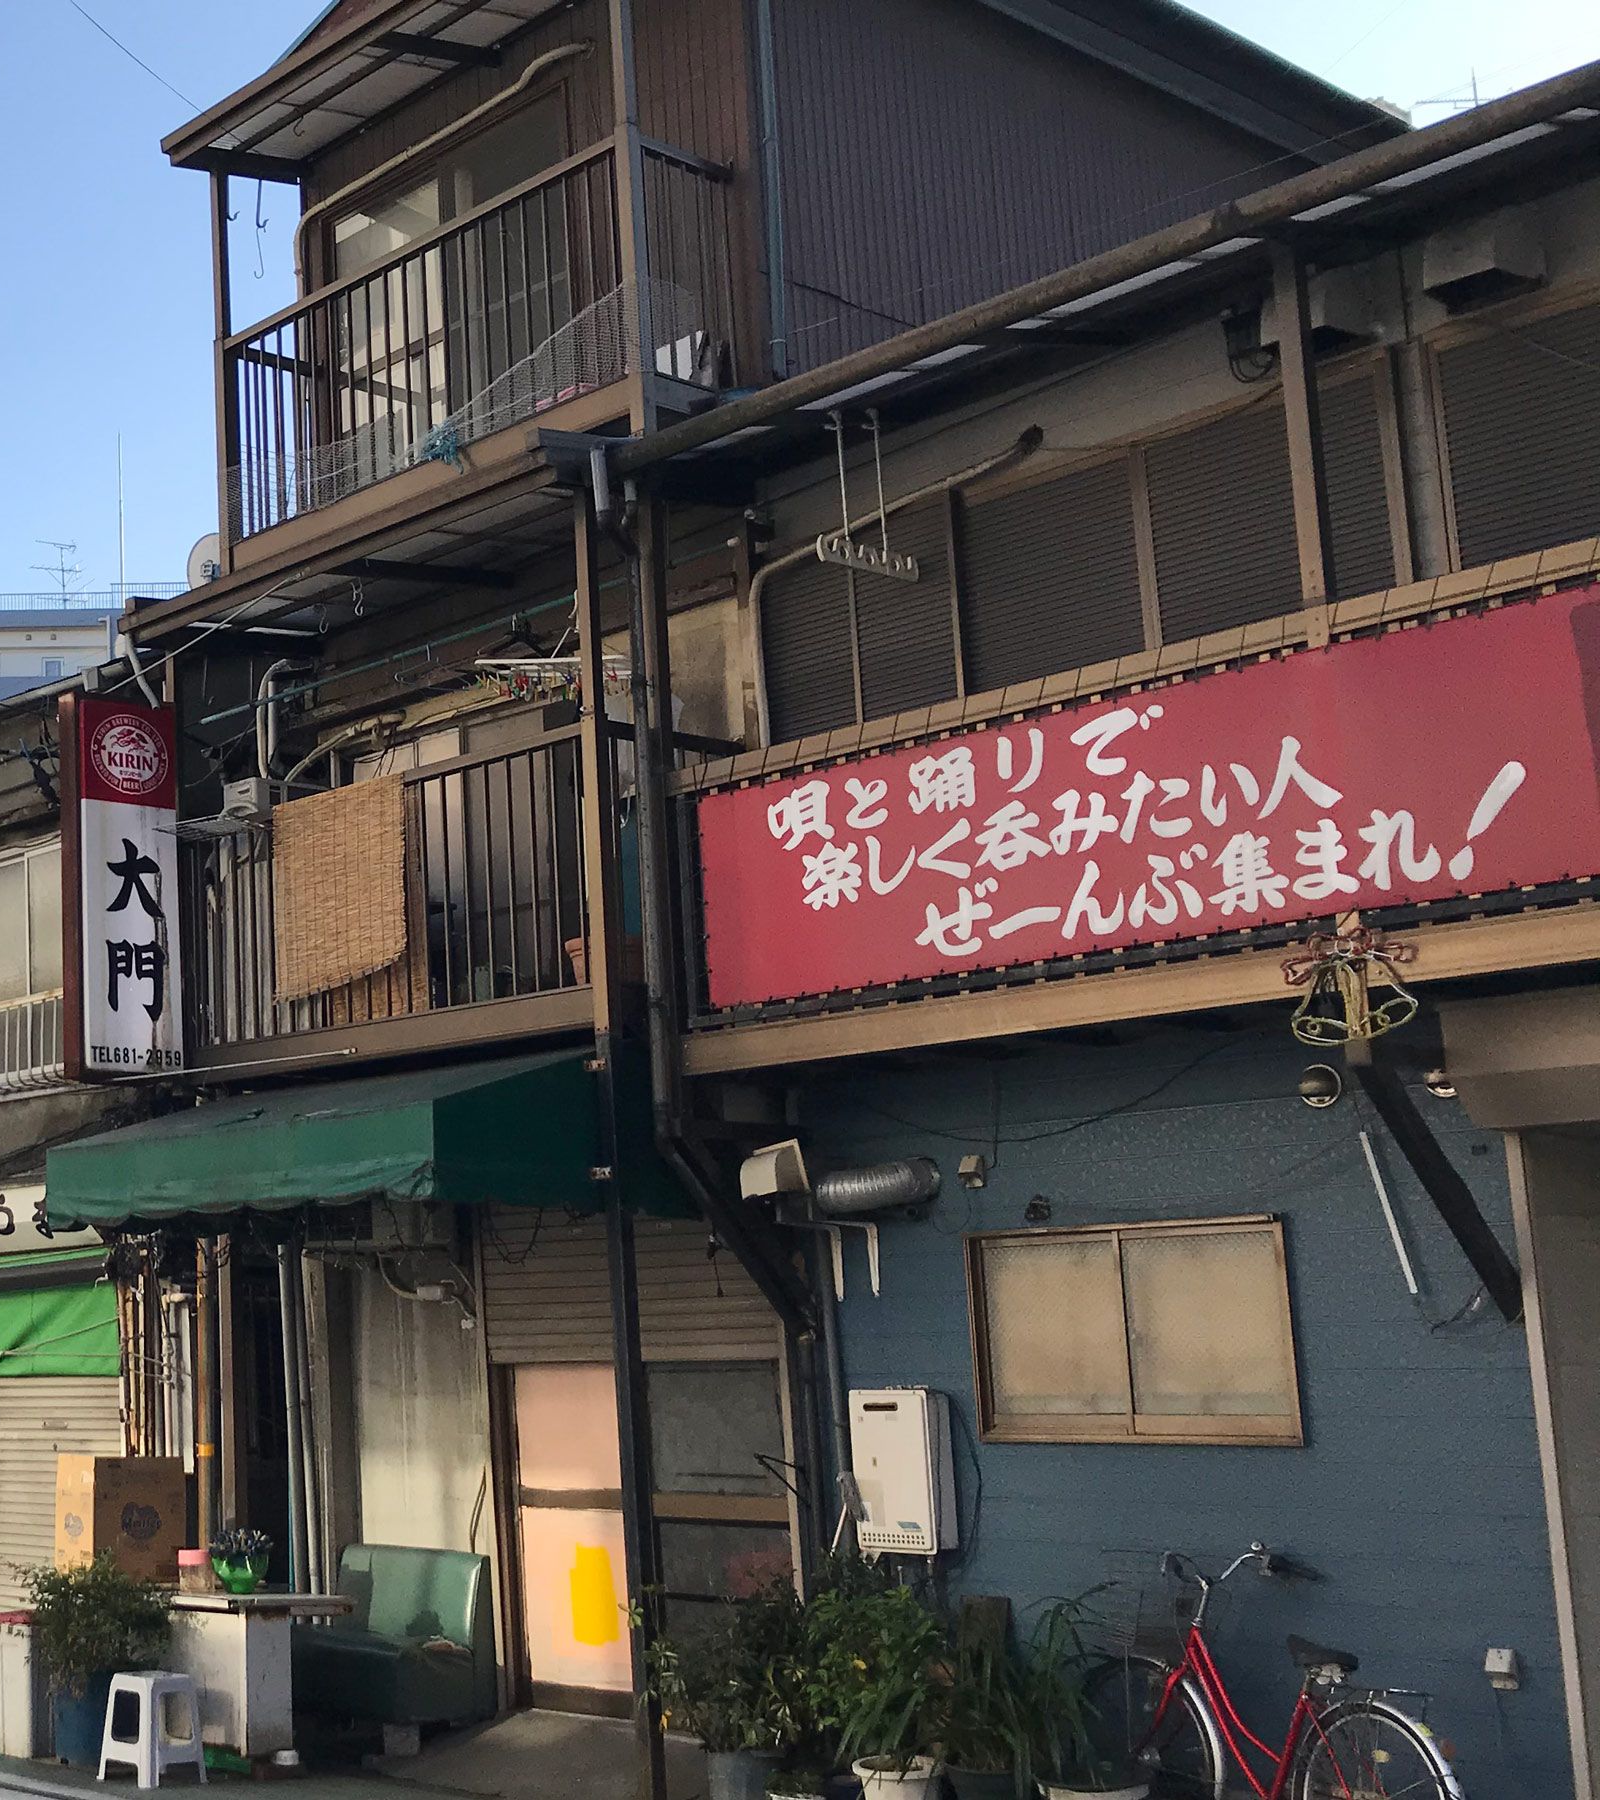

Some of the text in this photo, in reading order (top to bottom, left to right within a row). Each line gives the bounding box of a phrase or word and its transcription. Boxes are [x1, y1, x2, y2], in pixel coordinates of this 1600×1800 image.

[107, 752, 153, 772] KIRIN
[122, 780, 140, 790] BEER
[767, 704, 1163, 852] 唄と踊りで
[801, 735, 1344, 912] 楽しく呑みたい人
[106, 838, 165, 1022] 大門
